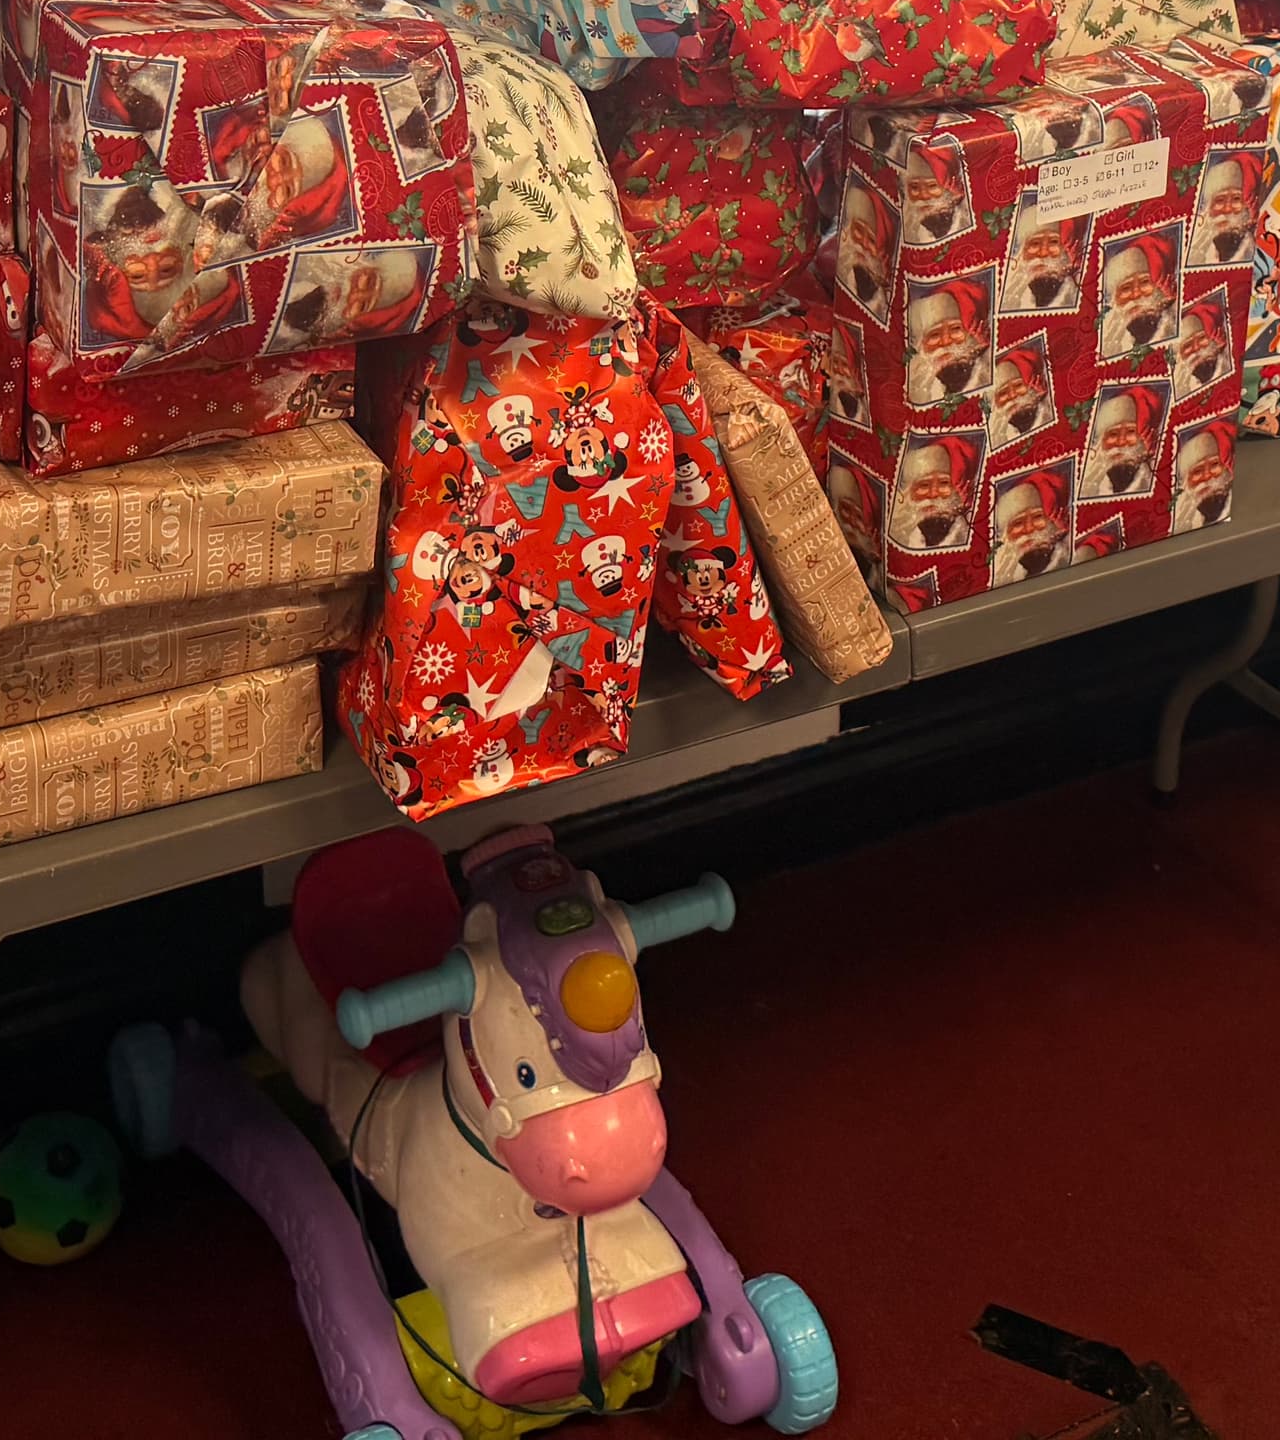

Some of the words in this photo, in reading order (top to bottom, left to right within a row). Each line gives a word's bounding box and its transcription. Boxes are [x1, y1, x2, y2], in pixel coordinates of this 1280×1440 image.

[1051, 165, 1071, 178] Boy
[1116, 149, 1135, 163] Girl
[1073, 176, 1089, 187] 3-5
[1106, 168, 1125, 180] 6-11
[1144, 161, 1159, 171] 12+
[314, 487, 334, 519] Ho
[160, 498, 182, 559] JOY
[778, 521, 836, 568] MERRY
[15, 552, 43, 622] Deck
[227, 562, 246, 581] &
[90, 715, 169, 749] PEACE
[183, 703, 208, 771] Deck
[210, 705, 224, 755] THE
[227, 693, 250, 752] Halls
[55, 777, 75, 827] JOY
